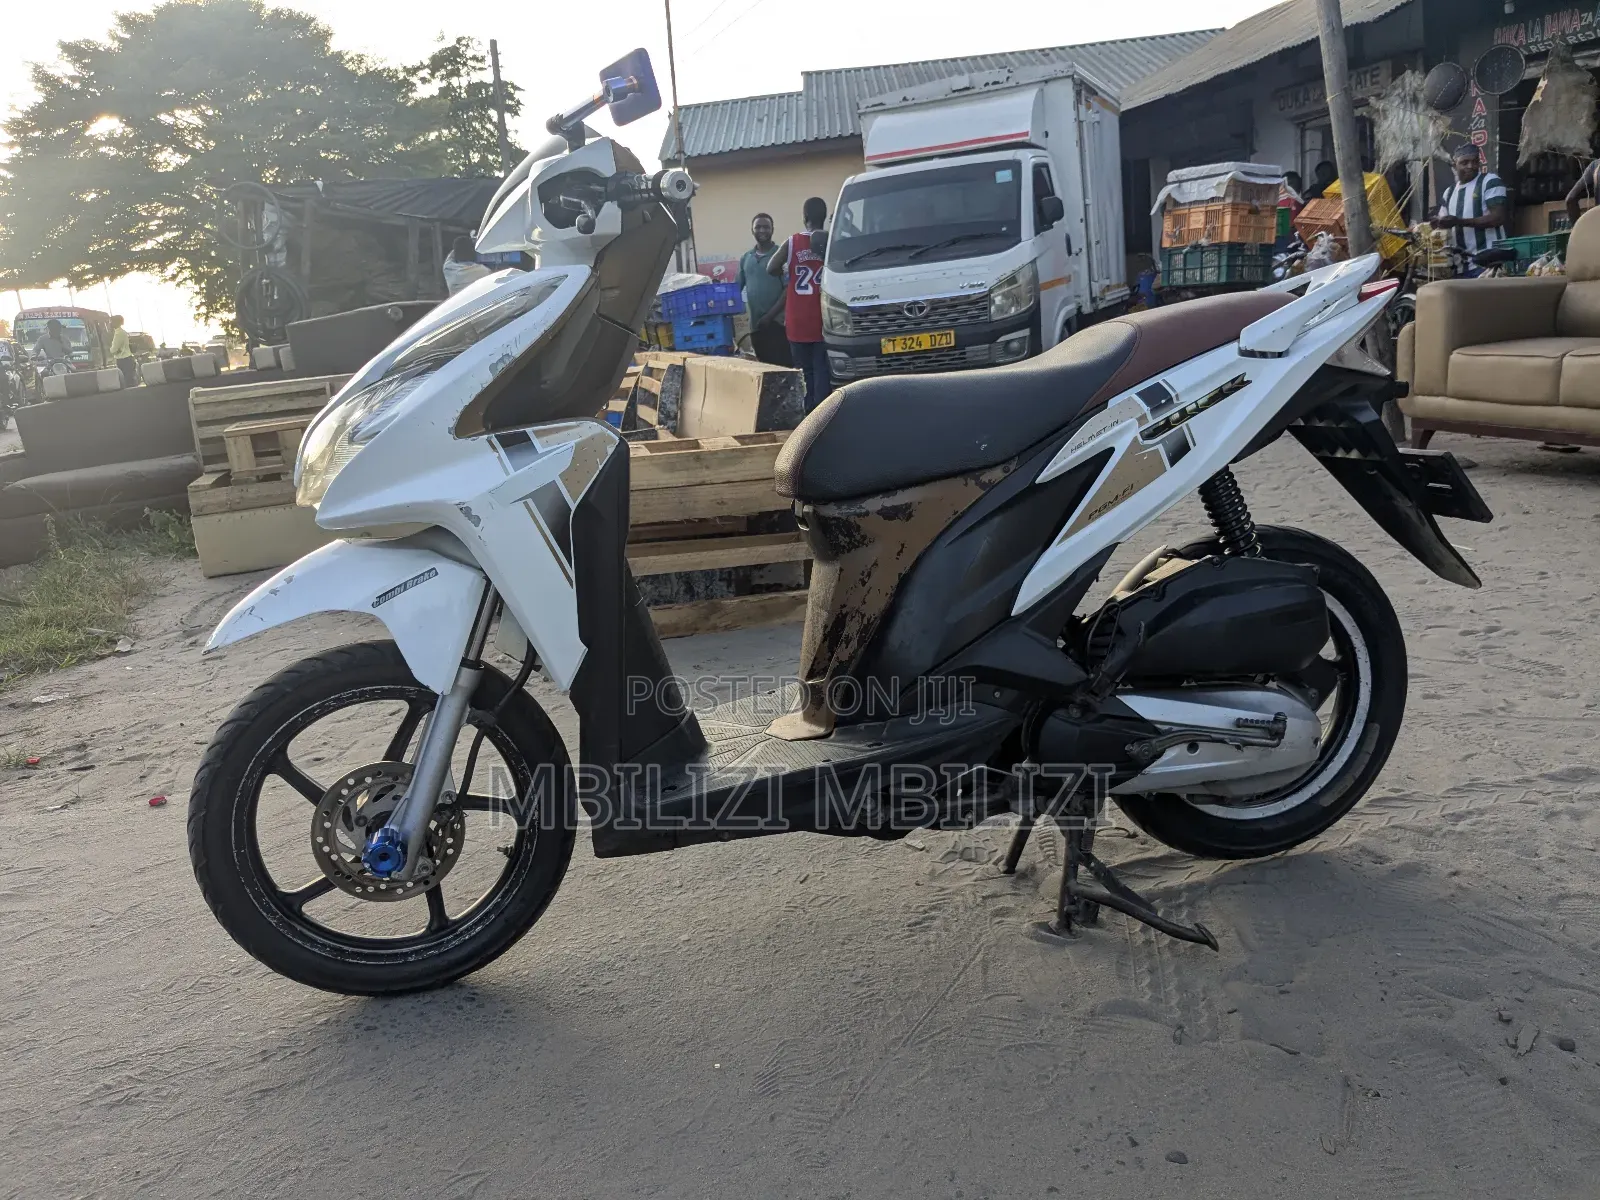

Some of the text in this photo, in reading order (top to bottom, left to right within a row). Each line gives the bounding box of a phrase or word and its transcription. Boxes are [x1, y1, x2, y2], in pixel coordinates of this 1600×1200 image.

[850, 294, 880, 302] INTRA
[888, 332, 952, 352] T 324 DZD
[372, 569, 436, 607] Combi Brake
